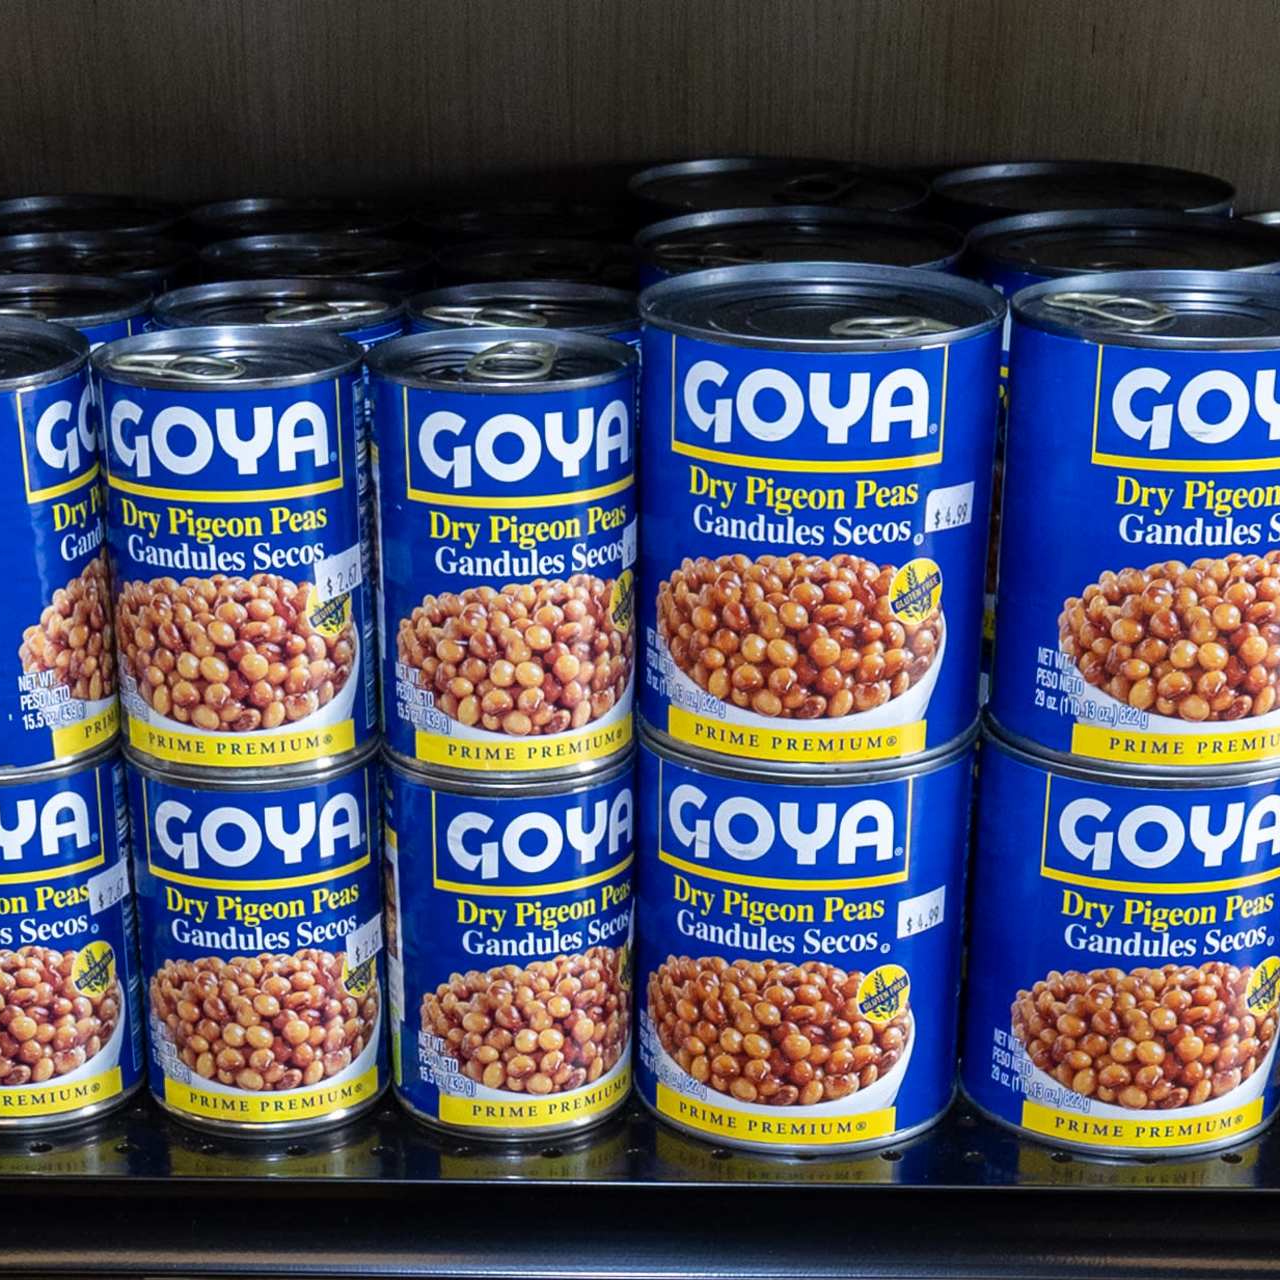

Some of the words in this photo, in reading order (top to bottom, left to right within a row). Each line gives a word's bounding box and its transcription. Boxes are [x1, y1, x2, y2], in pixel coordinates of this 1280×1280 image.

[683, 360, 930, 444] GOYA
[110, 399, 331, 477] GOYA
[420, 400, 629, 489] GOYA
[688, 465, 737, 508] Dry
[746, 476, 849, 517] Pigeon
[856, 478, 918, 506] Peas
[1116, 476, 1174, 517] Dry
[122, 499, 161, 541] Dry
[169, 507, 259, 544] Pigeon
[270, 504, 327, 534] Peas
[430, 508, 480, 550] Dry
[488, 510, 578, 547] Pigeon
[587, 504, 626, 538] Peas
[693, 502, 824, 546] Gandules
[832, 514, 911, 545] Secos
[1118, 513, 1261, 547] Gandules
[128, 535, 246, 572] Gandules
[253, 542, 326, 570] Secos
[435, 543, 565, 577] Gandules
[571, 541, 624, 573] Secos
[148, 732, 221, 756] PRIME
[448, 742, 516, 761] PRIME
[695, 722, 761, 748] PRIME
[155, 792, 362, 869] GOYA
[446, 788, 632, 880] GOYA
[667, 783, 896, 866] GOYA
[36, 884, 90, 911] Peas
[165, 885, 207, 924] Dry
[216, 889, 306, 925] Pigeon
[313, 882, 359, 913] Peas
[457, 898, 507, 936] Dry
[515, 893, 597, 933] Pigeon
[673, 874, 716, 917] Dry
[722, 888, 815, 927] Pigeon
[823, 899, 885, 924] Peas
[1061, 889, 1114, 929] Dry
[1122, 896, 1217, 933] Pigeon
[1225, 892, 1274, 922] Peas
[20, 915, 88, 943] Secos
[171, 920, 291, 952] Gandules
[297, 913, 358, 948] Secos
[462, 920, 580, 958] Gandules
[676, 910, 796, 954] Gandules
[802, 924, 877, 954] Secos
[1064, 926, 1196, 957] Gandules
[1203, 928, 1266, 955] Secos
[189, 1093, 253, 1113] PRIME
